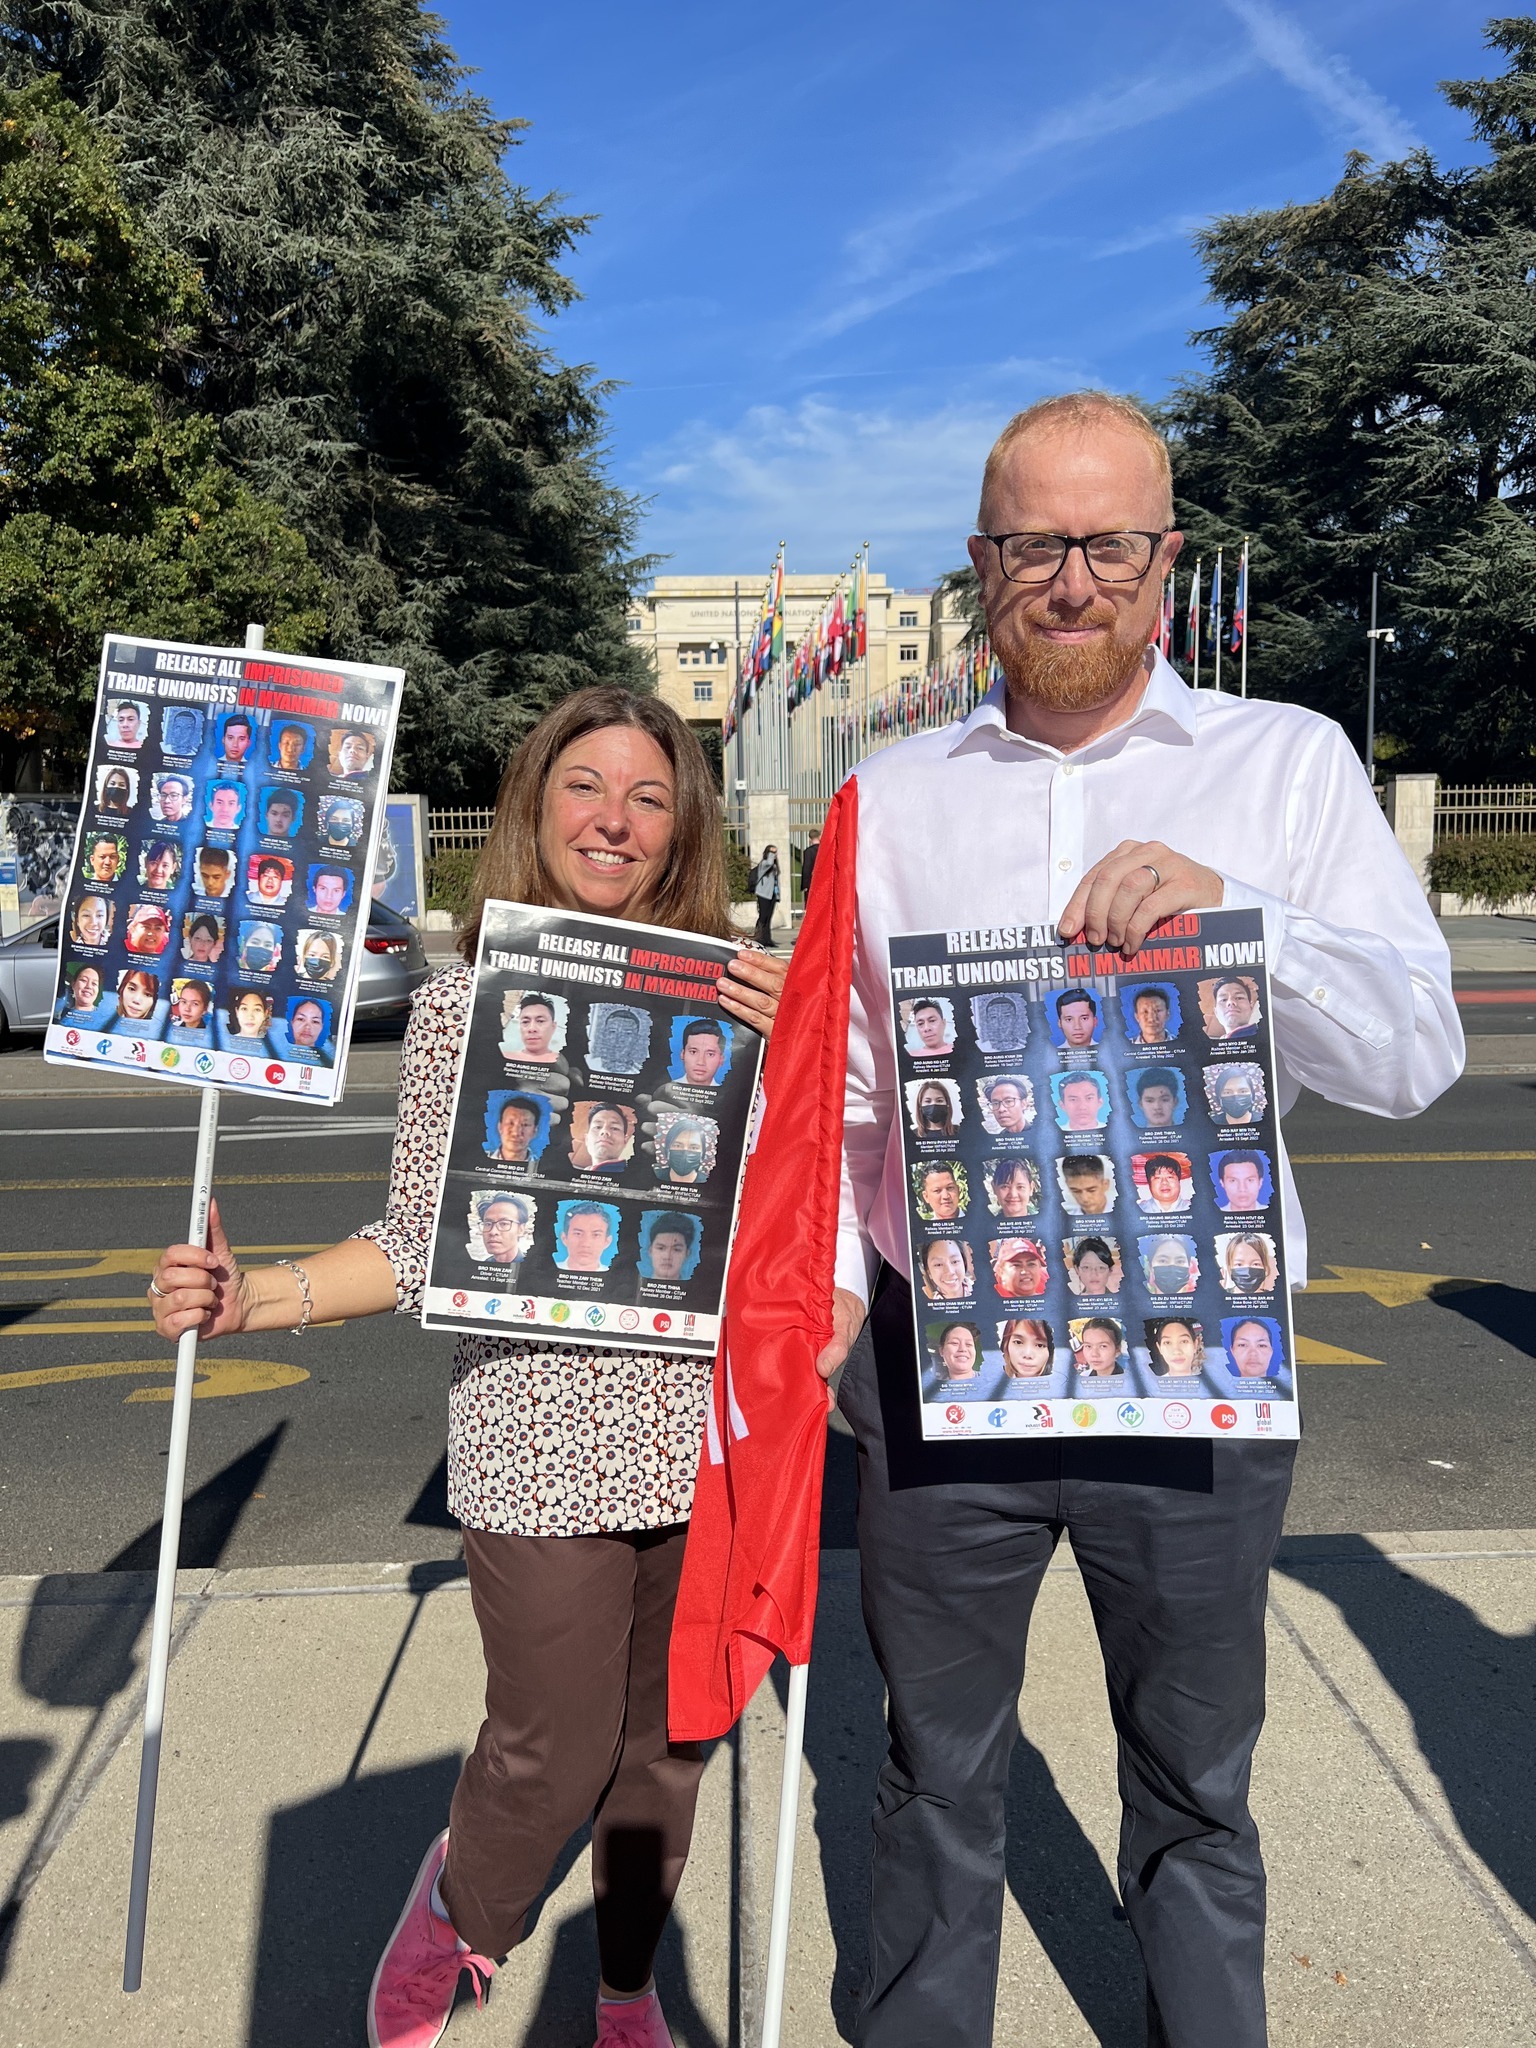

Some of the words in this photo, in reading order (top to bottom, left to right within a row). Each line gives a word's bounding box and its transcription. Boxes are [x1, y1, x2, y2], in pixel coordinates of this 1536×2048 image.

[156, 652, 217, 677] RELEASE
[218, 660, 242, 678] ALL
[244, 662, 344, 693] IMPRISONED
[107, 671, 156, 695] TRADE
[158, 678, 238, 705] UNIONISTS
[238, 688, 255, 706] IN
[258, 690, 339, 719] MYANMAR
[340, 704, 388, 726] NOW!
[538, 933, 602, 960] RELEASE
[603, 944, 629, 963] ALL
[630, 948, 725, 979] IMPRISONED
[947, 928, 1029, 953] RELEASE
[489, 950, 540, 974] TRADE
[541, 959, 624, 987] UNIONISTS
[624, 972, 642, 990] IN
[644, 974, 718, 1002] MYANMAR
[892, 966, 954, 988] TRADE
[957, 957, 1064, 985] UNIONISTS
[1068, 954, 1091, 978] IN
[1094, 946, 1201, 975] MYANMAR
[1204, 942, 1264, 968] NOW!
[272, 1072, 284, 1080] PSI
[660, 1320, 670, 1328] PSI
[1222, 1414, 1235, 1424] PSI
